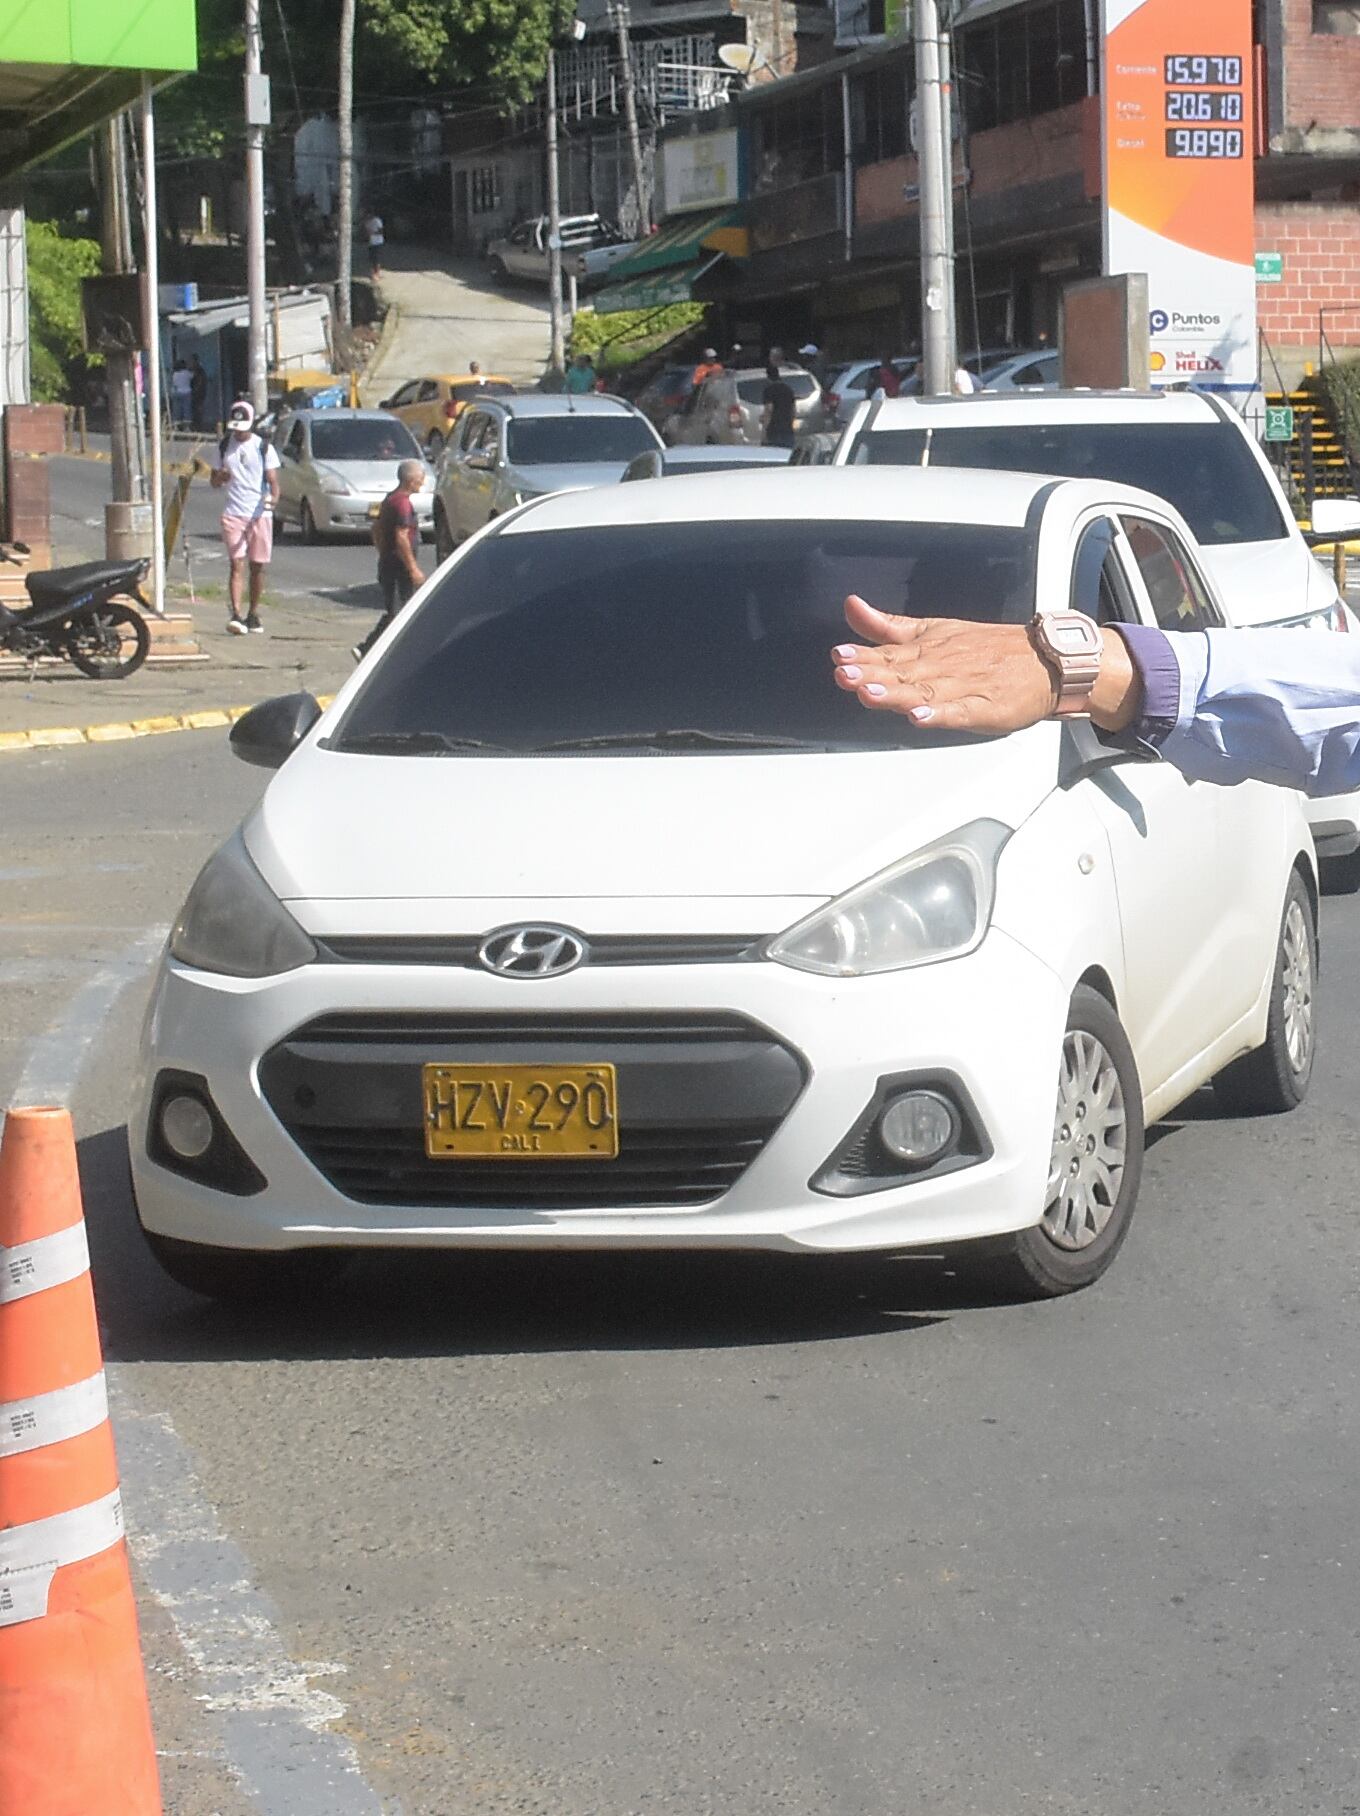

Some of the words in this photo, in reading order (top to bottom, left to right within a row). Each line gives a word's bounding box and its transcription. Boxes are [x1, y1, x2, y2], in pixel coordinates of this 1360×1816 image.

[1166, 57, 1241, 83] 15.970
[1175, 130, 1241, 157] 9.890
[1171, 312, 1221, 325] Puntos
[1175, 351, 1196, 359] Shell
[1175, 357, 1224, 371] HELIX
[431, 1080, 513, 1131] HZV
[526, 1080, 611, 1131] 290
[501, 1134, 541, 1151] CALI
